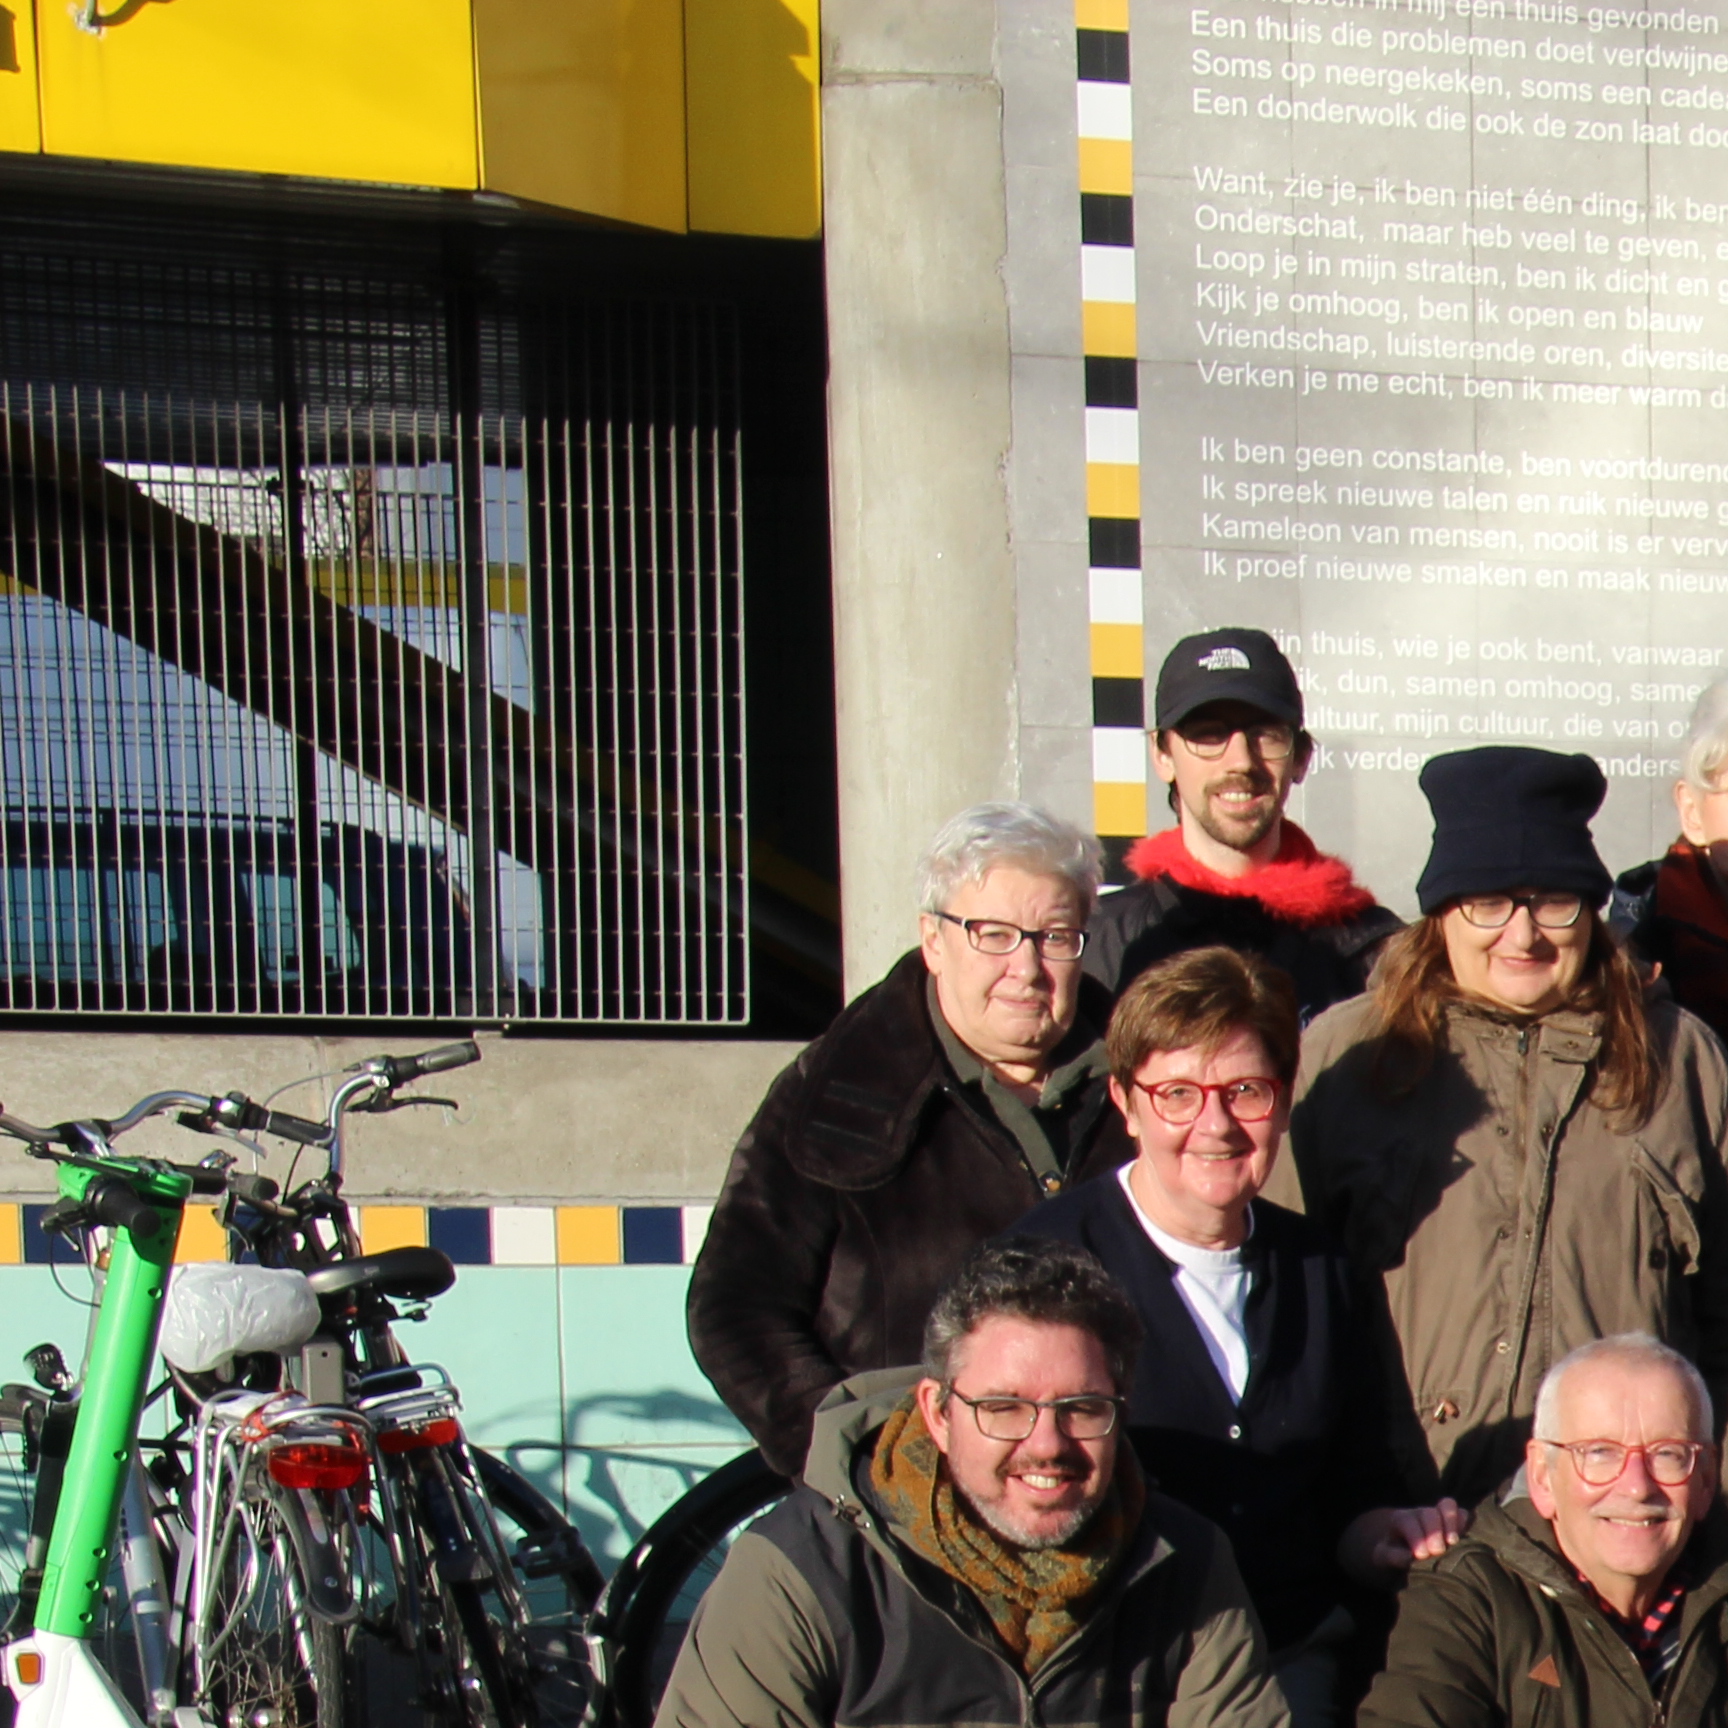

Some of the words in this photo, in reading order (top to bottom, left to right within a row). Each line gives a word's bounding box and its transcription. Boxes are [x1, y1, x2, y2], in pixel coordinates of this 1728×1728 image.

[1190, 13, 1246, 40] Een
[1255, 18, 1322, 45] thuis
[1330, 22, 1372, 48] die
[1381, 29, 1526, 58] problemen
[1535, 36, 1594, 63] doet
[1455, 0, 1505, 20] een
[1515, 0, 1577, 24] thuis
[1587, 8, 1717, 33] gevonden
[1191, 50, 1272, 79] Soms
[1280, 62, 1316, 87] op
[1324, 65, 1511, 99] neergekeken,
[1520, 79, 1593, 100] soms
[1600, 84, 1651, 104] een
[1192, 89, 1247, 116] Een
[1256, 93, 1417, 127] donderwolk
[1425, 104, 1466, 130] die
[1474, 110, 1525, 134] ook
[1532, 112, 1566, 137] de
[1572, 120, 1623, 140] zon
[1631, 118, 1682, 144] laat
[1192, 167, 1273, 200] Want,
[1283, 173, 1323, 198] zie
[1331, 175, 1364, 205] je,
[1374, 178, 1396, 203] ik
[1405, 180, 1455, 206] ben
[1465, 185, 1514, 210] niet
[1522, 187, 1572, 213] één
[1580, 191, 1645, 223] ding,
[1653, 195, 1676, 220] ik
[1194, 206, 1366, 243] Onderschat,
[1382, 223, 1454, 244] maar
[1461, 221, 1513, 247] heb
[1520, 227, 1577, 251] veel
[1584, 229, 1610, 253] te
[1617, 236, 1708, 262] geven,
[1194, 244, 1265, 277] Loop
[1272, 248, 1298, 278] je
[1306, 250, 1331, 275] in
[1340, 253, 1396, 284] mijn
[1404, 258, 1506, 289] straten,
[1515, 263, 1566, 289] ben
[1575, 266, 1596, 290] ik
[1603, 268, 1669, 295] dicht
[1676, 278, 1709, 297] en
[1196, 282, 1248, 313] Kijk
[1254, 285, 1279, 315] je
[1287, 289, 1408, 322] omhoog,
[1417, 294, 1469, 320] ben
[1477, 297, 1500, 322] ik
[1507, 305, 1575, 329] open
[1583, 309, 1616, 328] en
[1625, 305, 1703, 332] blauw
[1196, 320, 1377, 359] Vriendschap,
[1386, 331, 1536, 362] luisterende
[1542, 346, 1612, 370] oren,
[1196, 359, 1294, 387] Verken
[1301, 364, 1328, 394] je
[1336, 372, 1379, 391] me
[1387, 370, 1454, 399] echt,
[1463, 372, 1513, 398] ben
[1522, 375, 1545, 399] ik
[1551, 383, 1622, 403] meer
[1628, 387, 1702, 407] warm
[1200, 436, 1226, 461] Ik
[1234, 437, 1286, 463] ben
[1295, 446, 1363, 470] geen
[1372, 447, 1513, 477] constante,
[1520, 450, 1571, 475] ben
[1201, 474, 1226, 499] Ik
[1233, 478, 1328, 506] spreek
[1335, 480, 1433, 507] nieuwe
[1441, 485, 1508, 510] talen
[1516, 493, 1550, 512] en
[1558, 490, 1607, 514] ruik
[1615, 492, 1709, 518] nieuwe
[1201, 513, 1341, 542] Kameleon
[1349, 525, 1400, 544] van
[1408, 527, 1524, 553] mensen,
[1533, 528, 1600, 552] nooit
[1607, 528, 1628, 553] is
[1636, 536, 1665, 554] er
[1202, 550, 1227, 575] Ik
[1234, 554, 1308, 582] proef
[1314, 555, 1412, 582] nieuwe
[1420, 560, 1527, 585] smaken
[1535, 568, 1568, 587] en
[1577, 566, 1651, 589] maak
[1310, 628, 1383, 658] thuis,
[1392, 631, 1438, 656] wie
[1447, 632, 1470, 662] je
[1478, 635, 1528, 659] ook
[1536, 636, 1602, 665] bent,
[1610, 644, 1724, 665] vanwaar
[1337, 668, 1396, 698] dun,
[1405, 676, 1497, 697] samen
[1504, 675, 1621, 705] omhoog,
[1629, 679, 1704, 703] same
[1304, 706, 1384, 736] ultuur,
[1393, 709, 1449, 739] mijn
[1458, 711, 1554, 741] cultuur,
[1562, 713, 1603, 738] die
[1611, 721, 1659, 739] van
